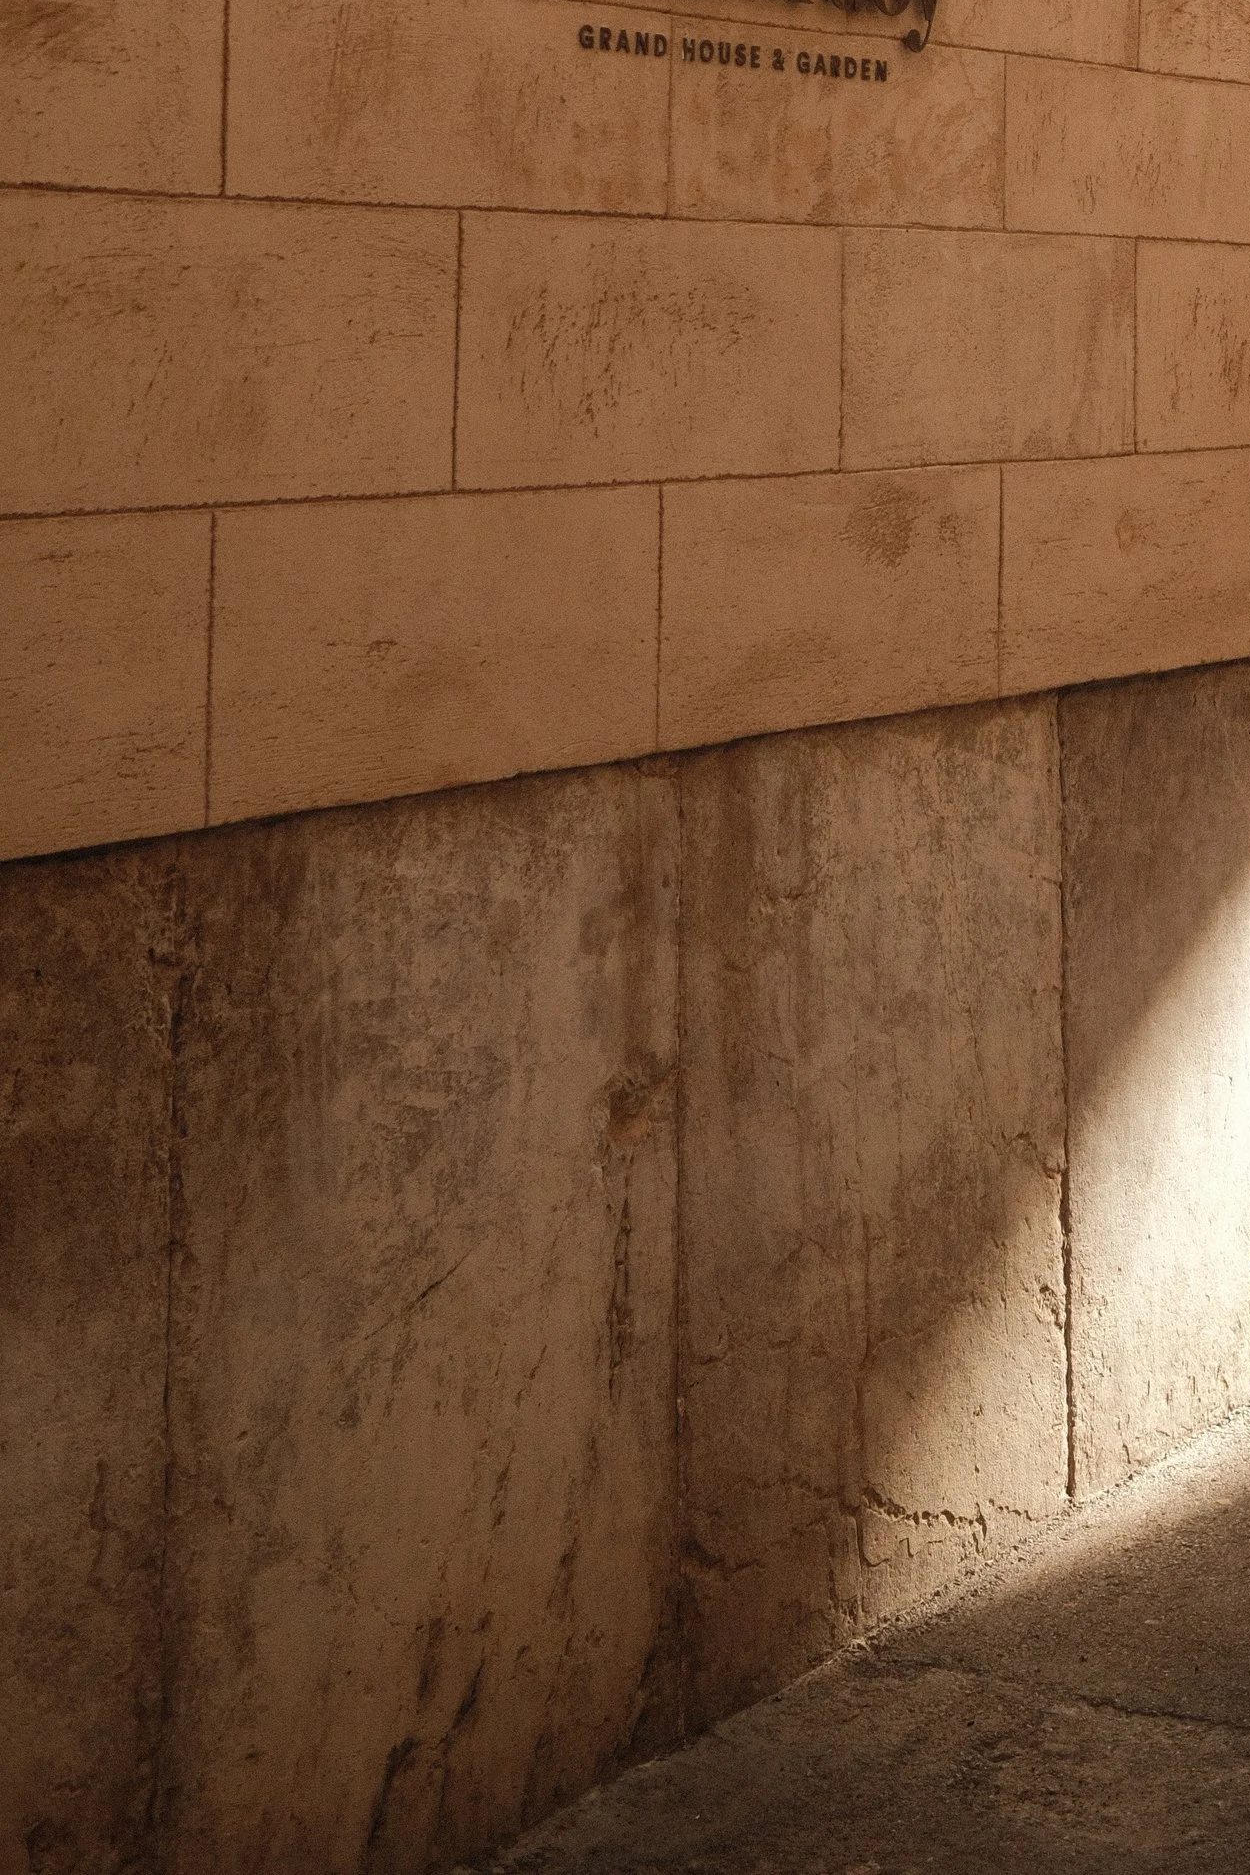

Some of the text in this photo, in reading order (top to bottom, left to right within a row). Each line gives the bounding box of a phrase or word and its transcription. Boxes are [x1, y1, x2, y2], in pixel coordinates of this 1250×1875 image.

[579, 24, 889, 83] GRAND HOUSE & GARDEN
